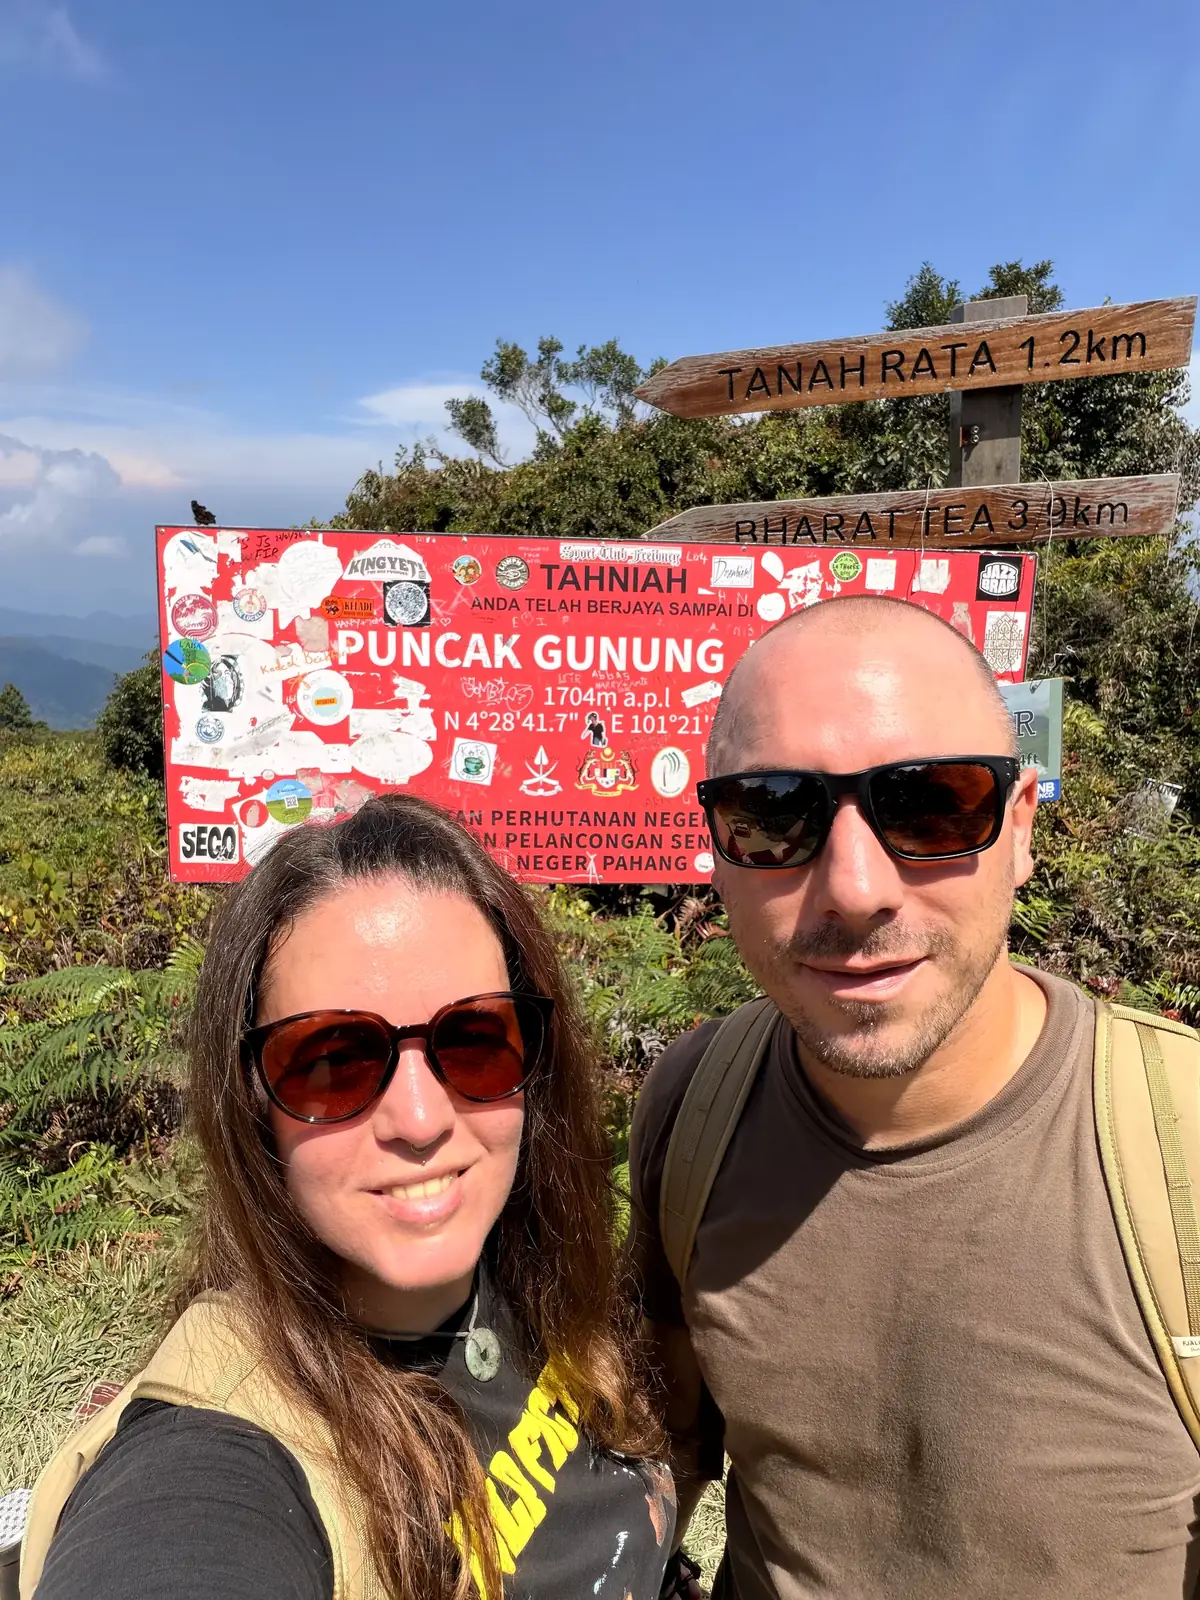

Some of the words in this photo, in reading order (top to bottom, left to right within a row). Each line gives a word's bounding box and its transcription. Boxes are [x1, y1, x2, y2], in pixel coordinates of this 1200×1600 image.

[718, 355, 865, 402] TANAH
[881, 340, 997, 384] RATA
[1019, 329, 1147, 371] 1.2km
[735, 509, 905, 544] BHARAT
[916, 504, 995, 538] TEA
[540, 564, 687, 593] TAHNIAH
[983, 564, 1017, 580] JAZZ
[471, 596, 520, 612] ANDA
[525, 598, 582, 613] TELAH
[587, 600, 665, 616] BERJAYA
[669, 602, 732, 617] SAMPAI
[738, 604, 754, 617] DI
[336, 629, 523, 669] PUNCAK
[533, 634, 724, 674] GUNUNG
[543, 687, 617, 707] 1704m
[623, 686, 671, 713] a.p.l
[444, 710, 460, 731] N
[465, 711, 579, 733] 4°28'41.7"
[611, 714, 624, 734] E
[630, 714, 715, 735] 101°21'
[1012, 709, 1037, 737] R
[491, 810, 636, 828] PERHUTANAN
[505, 832, 663, 849] PELANCONGAN
[671, 834, 710, 849] SEN
[603, 855, 688, 871] PAHANG
